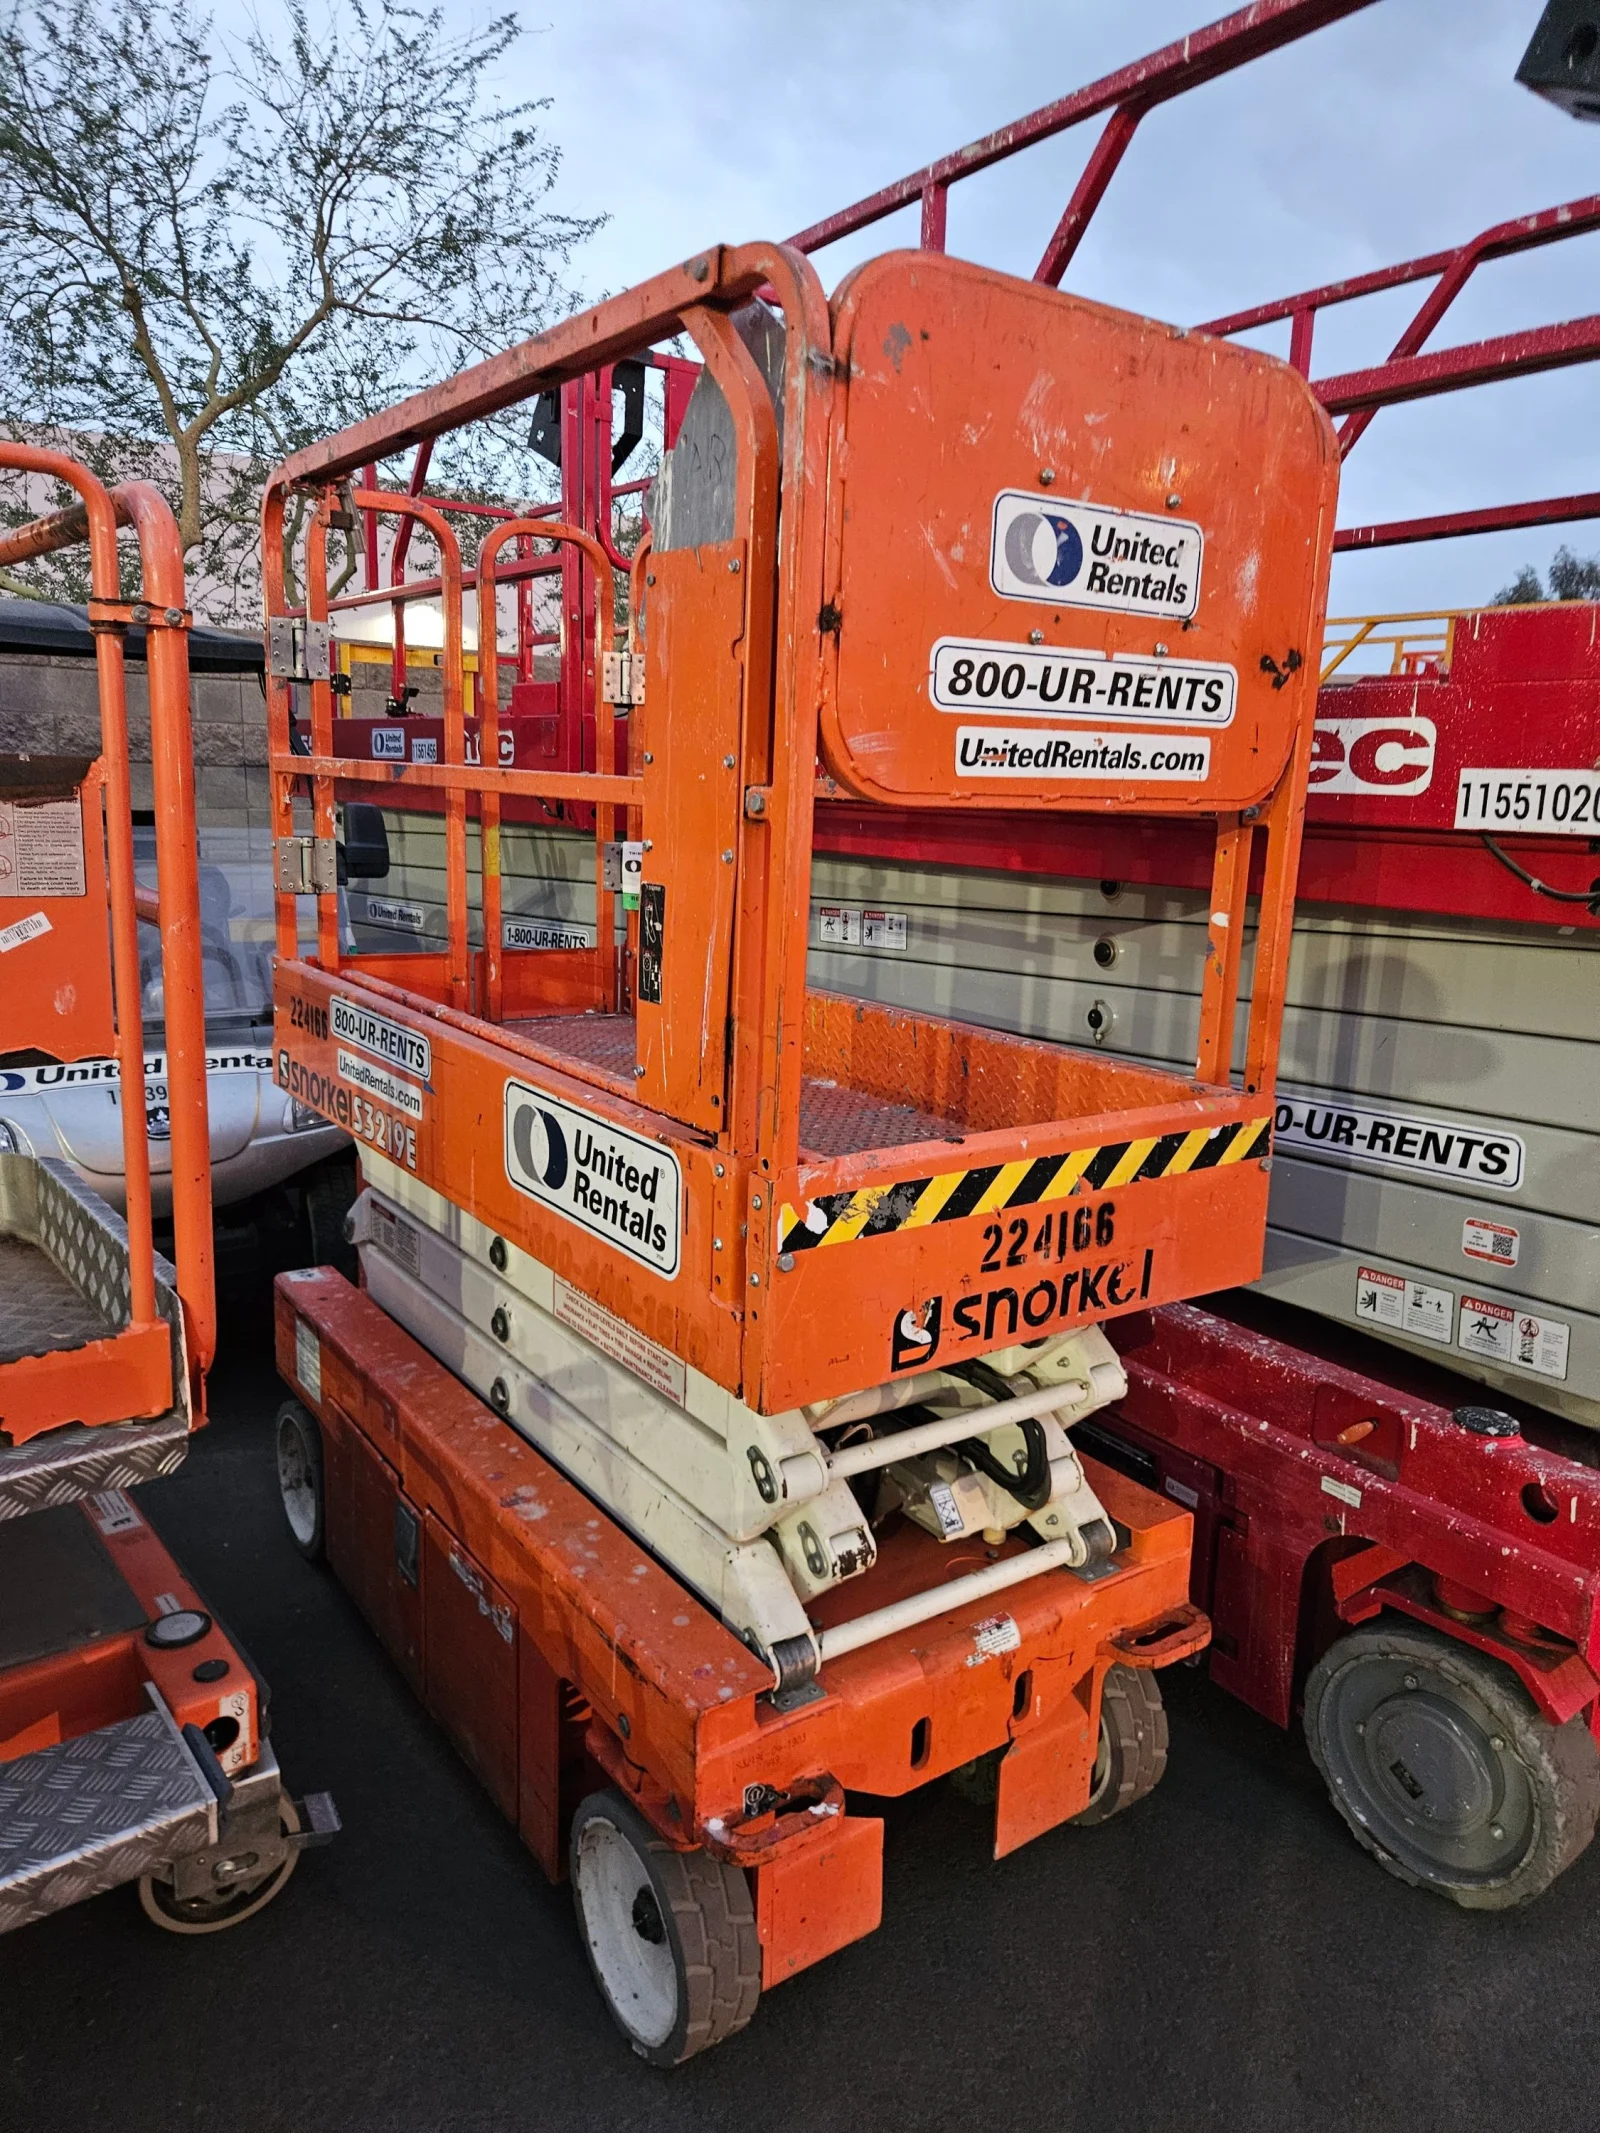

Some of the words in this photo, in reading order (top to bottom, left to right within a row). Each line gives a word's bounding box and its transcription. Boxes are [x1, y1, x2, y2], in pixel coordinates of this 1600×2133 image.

[1091, 525, 1185, 568] United
[1087, 562, 1188, 604] Rentals
[948, 659, 1224, 713] 800-UR-RENTS
[959, 738, 1205, 771] UnitedRentals.com
[378, 906, 398, 919] United
[398, 909, 422, 924] Rentals
[507, 926, 586, 949] 1-800-UR-RENTS
[290, 996, 328, 1041] 224166
[334, 1008, 425, 1069] 800-UR-RENTS
[339, 1054, 420, 1113] UnitedRentals.com
[292, 1060, 353, 1128] snorkel
[353, 1095, 417, 1171] S3219E
[1274, 1104, 1511, 1176] 0-UR-RENTS
[573, 1128, 660, 1204] United
[572, 1169, 668, 1253] Rentals
[980, 1202, 1116, 1273] 224166
[952, 1248, 1154, 1342] snorkel
[1370, 1272, 1404, 1289] DANGER
[1474, 1301, 1513, 1320] DANGER
